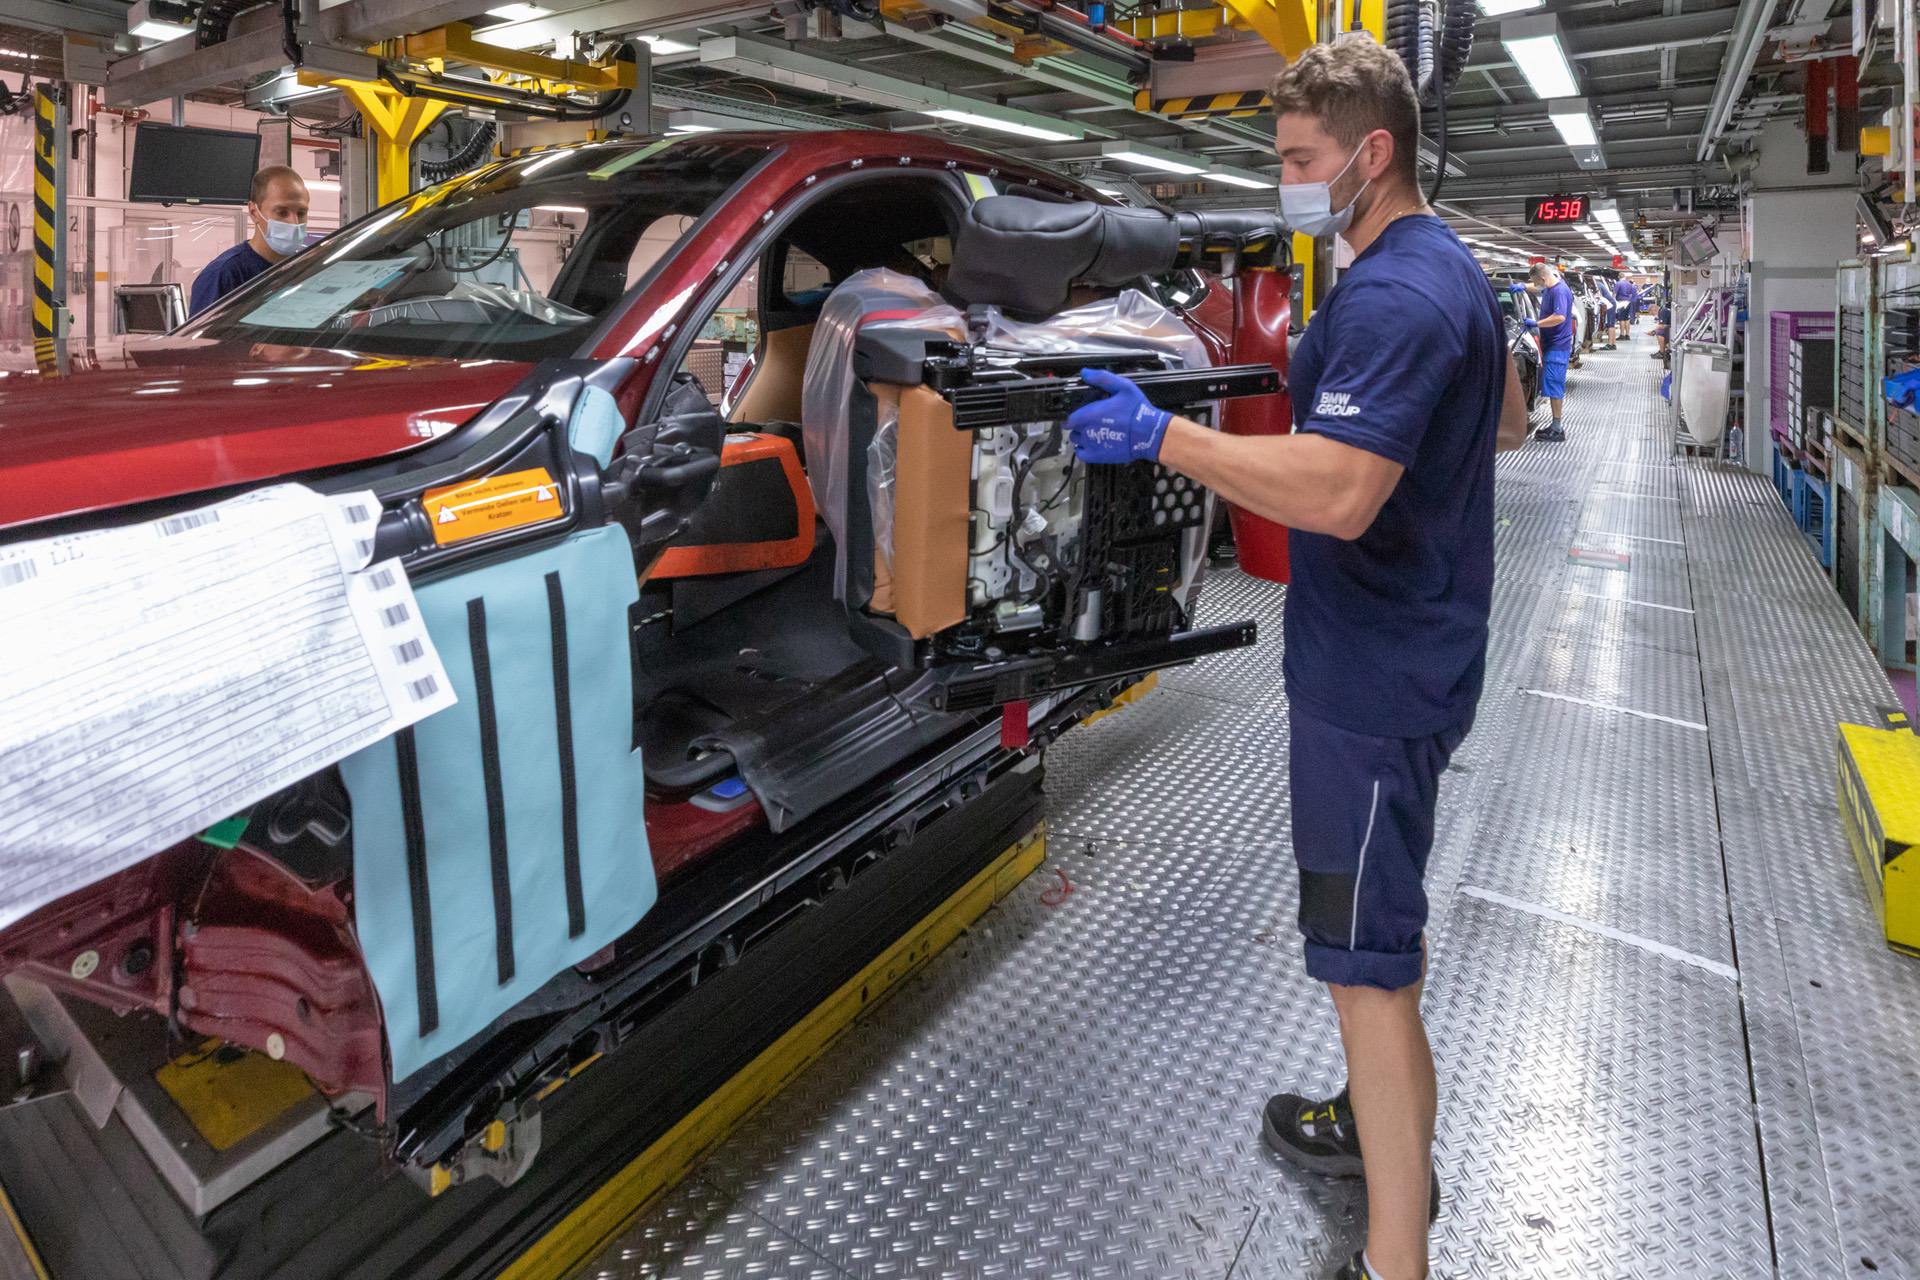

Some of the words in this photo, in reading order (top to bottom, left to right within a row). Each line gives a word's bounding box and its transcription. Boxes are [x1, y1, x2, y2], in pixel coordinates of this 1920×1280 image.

[1538, 201, 1581, 219] 15:38
[1320, 391, 1351, 404] BMW
[1316, 404, 1361, 416] GROUP
